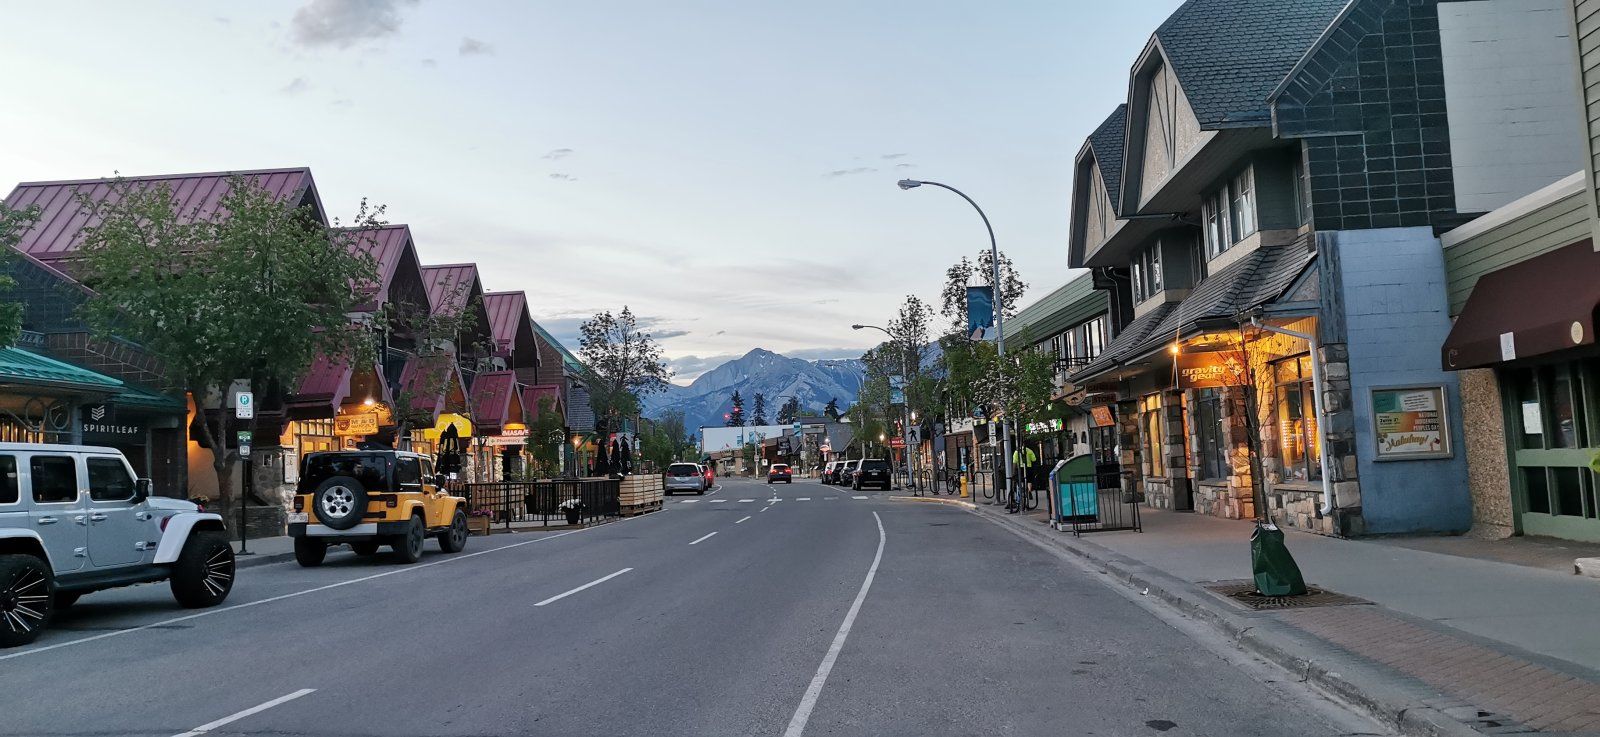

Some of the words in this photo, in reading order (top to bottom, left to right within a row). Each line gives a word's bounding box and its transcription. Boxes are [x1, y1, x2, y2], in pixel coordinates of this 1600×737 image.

[1182, 365, 1225, 377] gravity
[1190, 373, 1217, 383] gear
[84, 423, 138, 434] SPIRITLEAF
